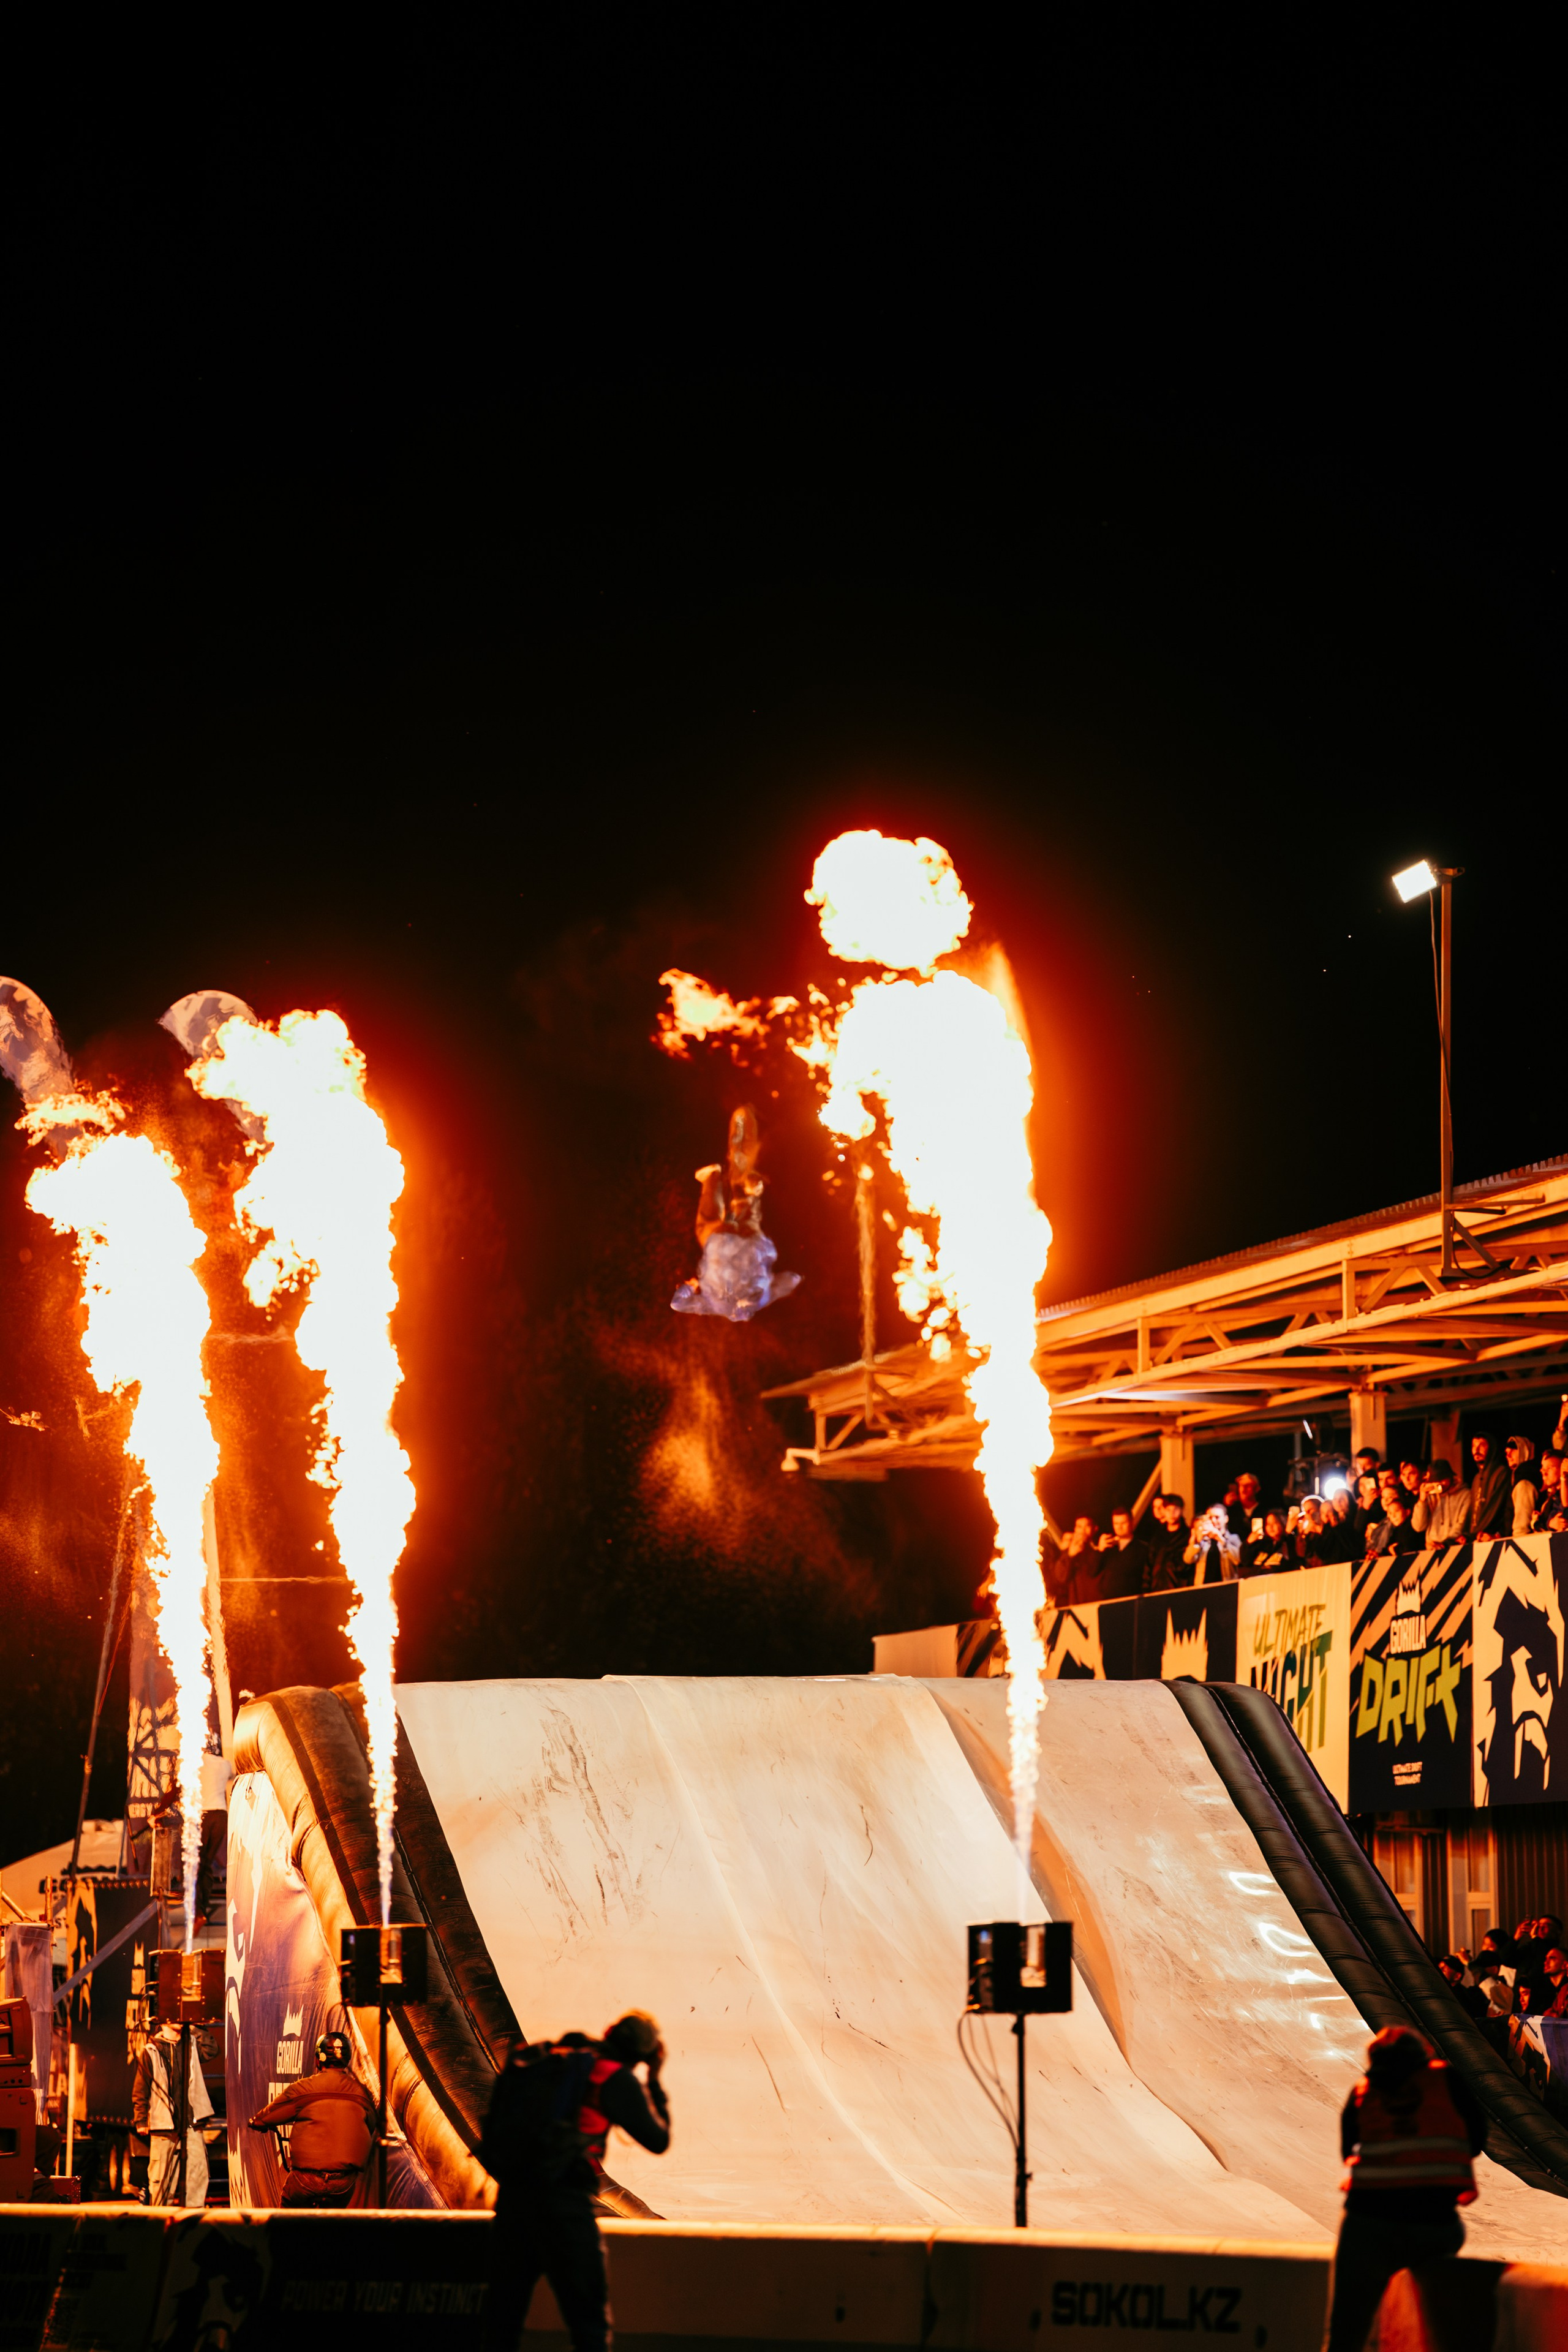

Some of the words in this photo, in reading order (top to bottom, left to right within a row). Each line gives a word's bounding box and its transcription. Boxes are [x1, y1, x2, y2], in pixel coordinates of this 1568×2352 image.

[1254, 1604, 1327, 1657] ULTIMATE
[1390, 1615, 1427, 1654] GORILLA
[1355, 1643, 1461, 1748] DRIFT
[277, 2040, 304, 2075] GORILLA
[280, 2280, 349, 2312] POWER
[353, 2280, 404, 2313] YOUR
[405, 2281, 490, 2315] INSTINCT
